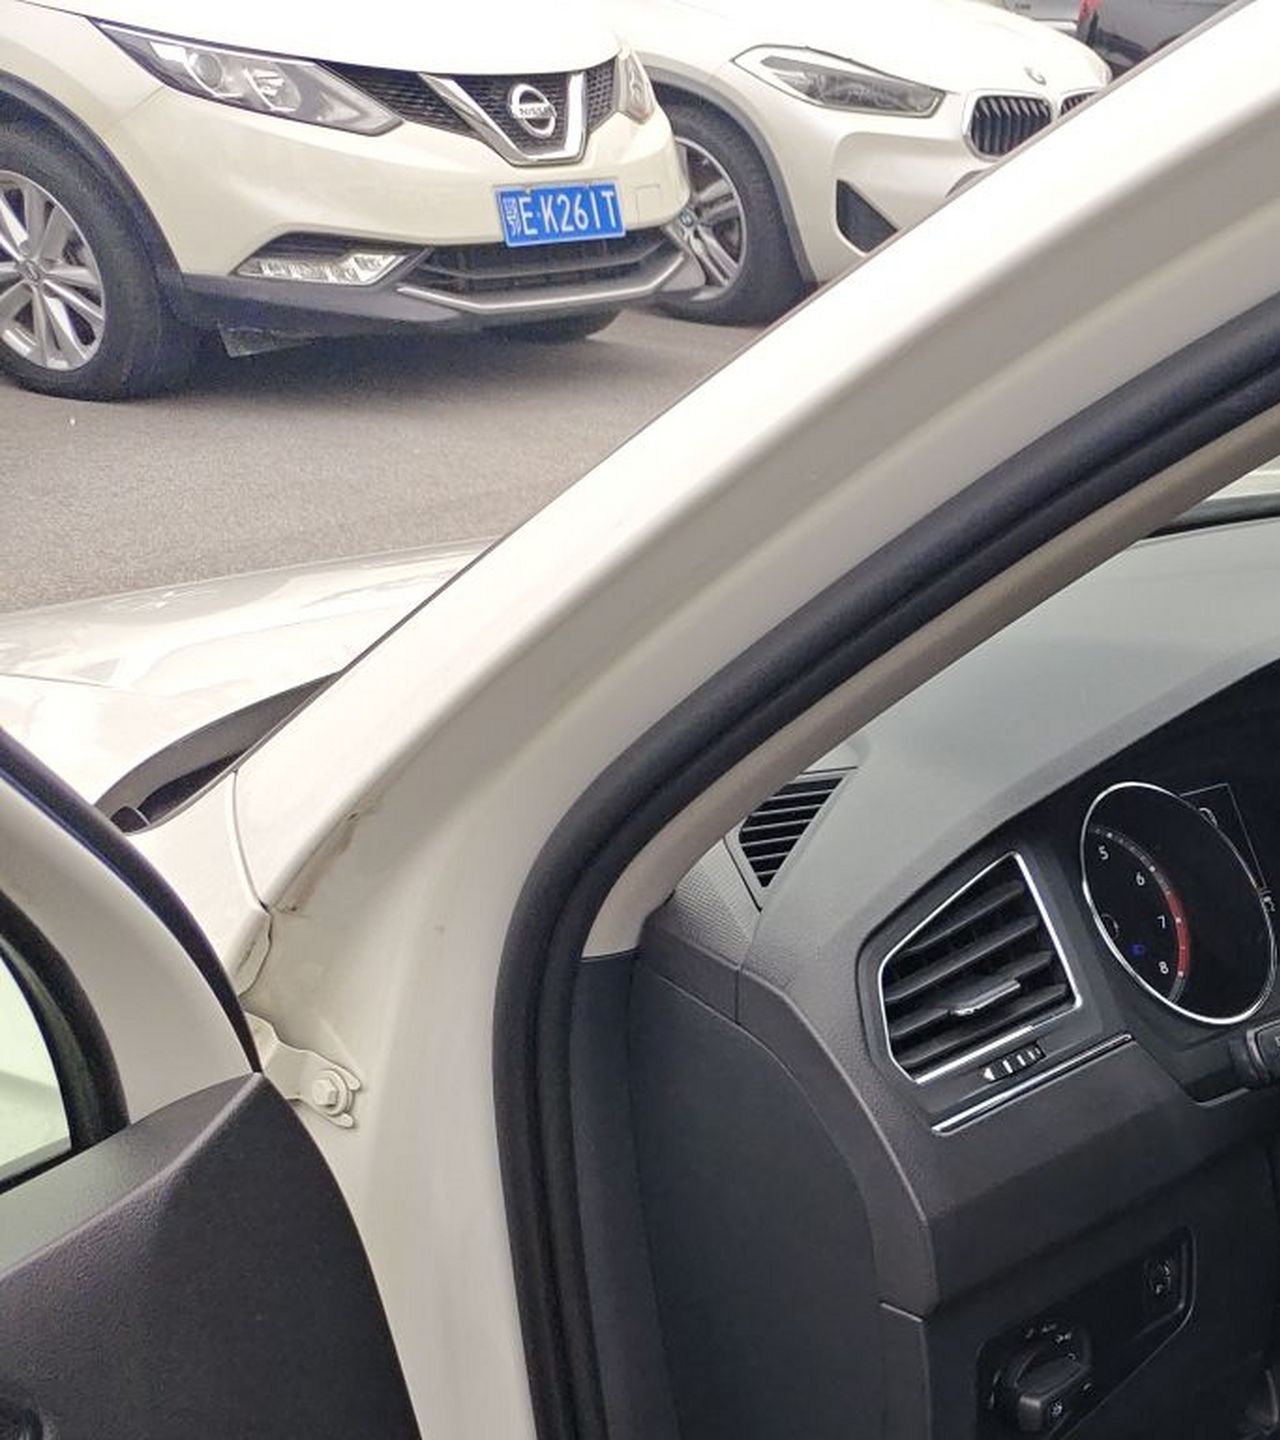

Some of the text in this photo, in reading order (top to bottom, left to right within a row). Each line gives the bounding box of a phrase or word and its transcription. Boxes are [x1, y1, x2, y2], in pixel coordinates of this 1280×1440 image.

[1098, 845, 1109, 860] 5
[1135, 872, 1146, 886] 6
[1156, 915, 1167, 929] 7
[1158, 961, 1170, 975] 8
